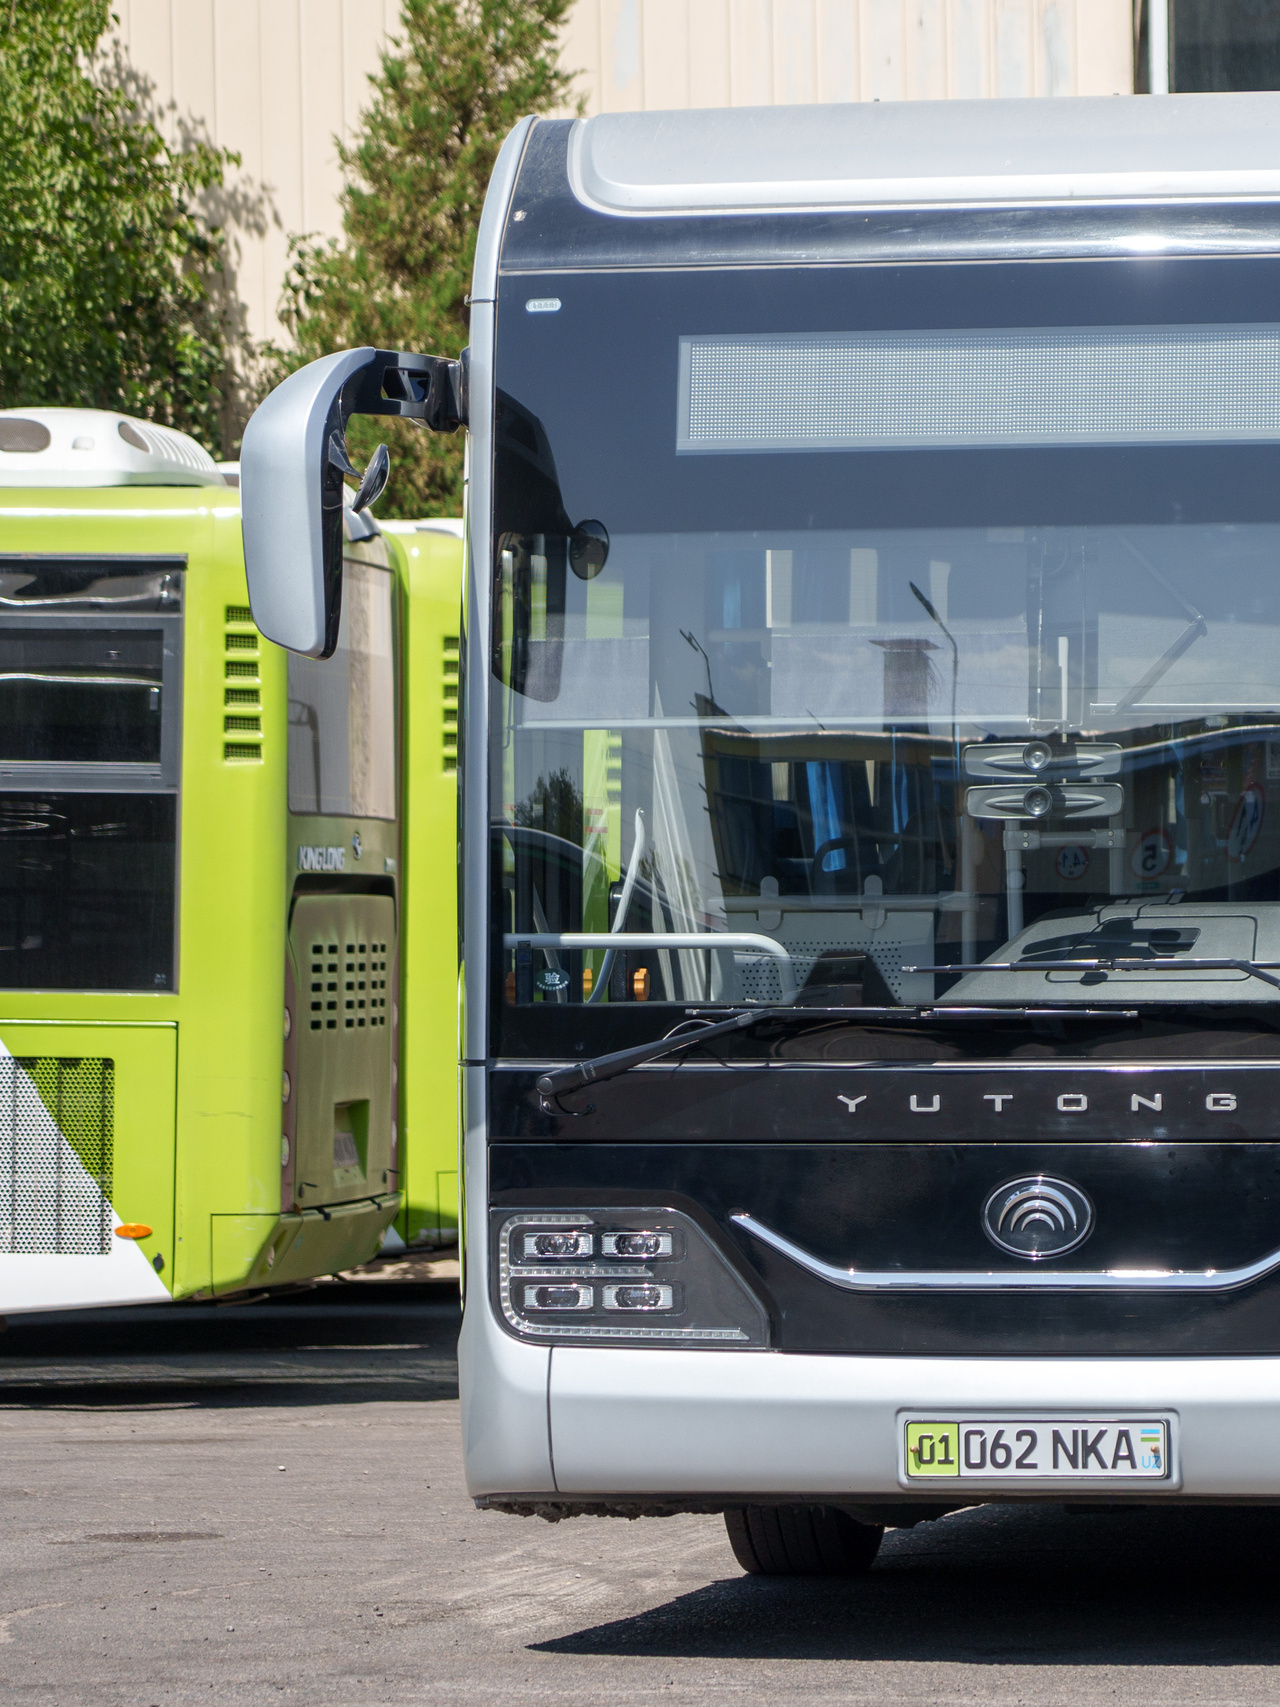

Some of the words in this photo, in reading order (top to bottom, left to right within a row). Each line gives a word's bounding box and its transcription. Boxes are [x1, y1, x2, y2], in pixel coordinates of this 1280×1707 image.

[837, 1093, 1238, 1113] YUTONG
[917, 1433, 955, 1465] 01
[964, 1429, 1039, 1470] 062
[1052, 1428, 1138, 1470] NKA
[1141, 1455, 1161, 1469] UZ
